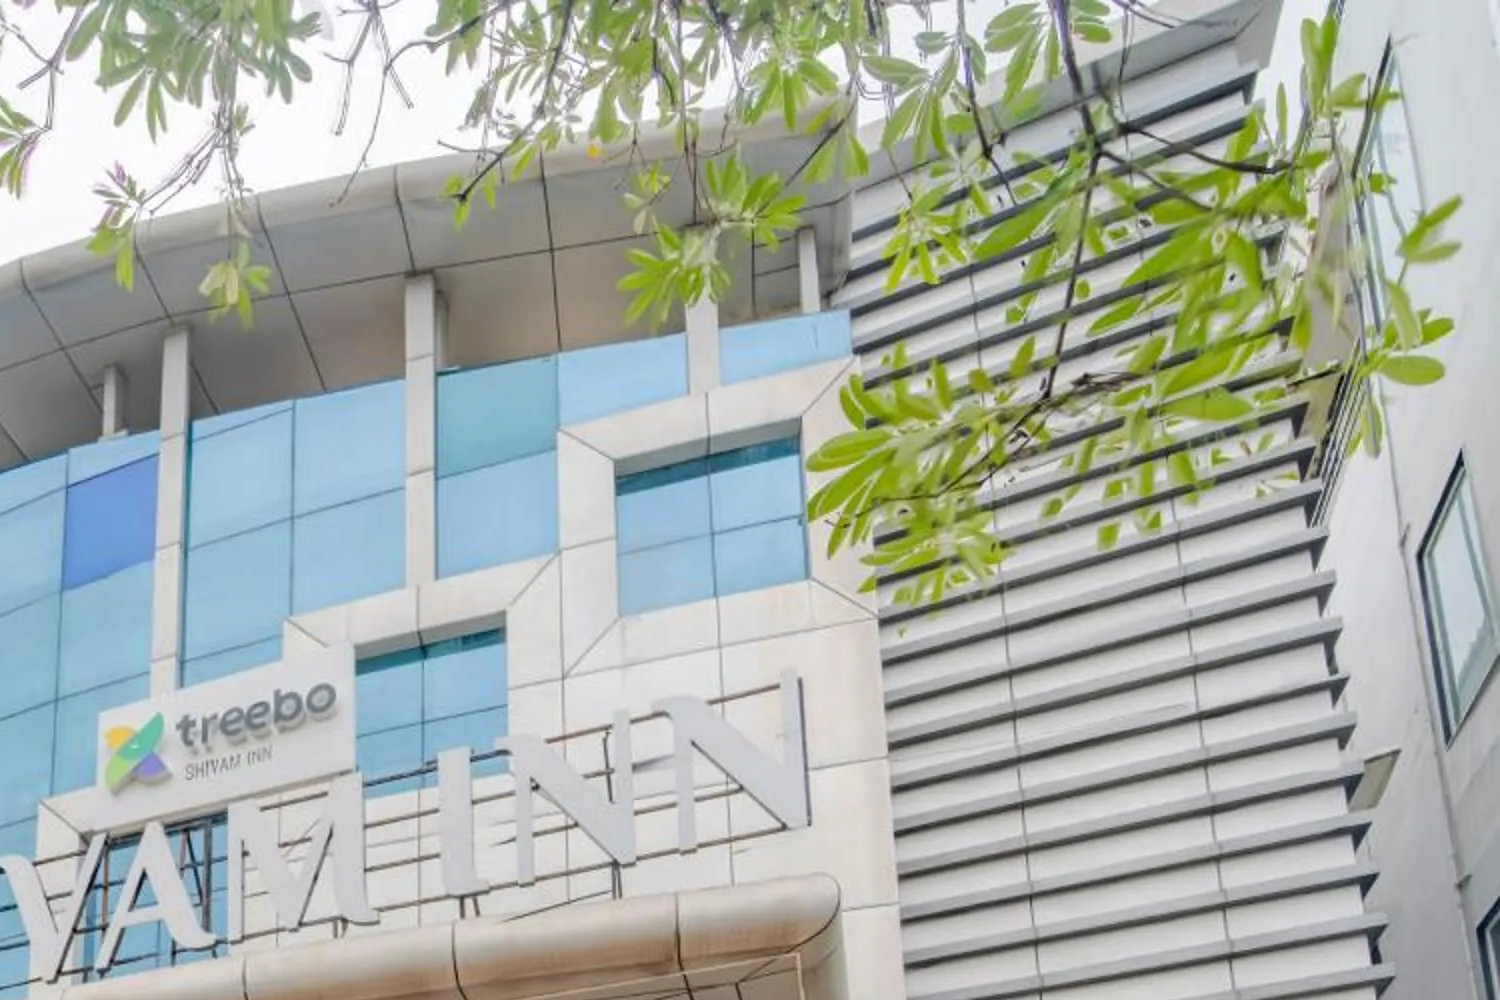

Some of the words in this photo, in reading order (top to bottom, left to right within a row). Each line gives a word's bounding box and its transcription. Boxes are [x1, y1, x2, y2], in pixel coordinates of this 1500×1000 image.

[175, 682, 338, 749] treebo
[184, 752, 242, 781] SHIVAM
[247, 744, 274, 766] INN
[438, 668, 811, 898] INN
